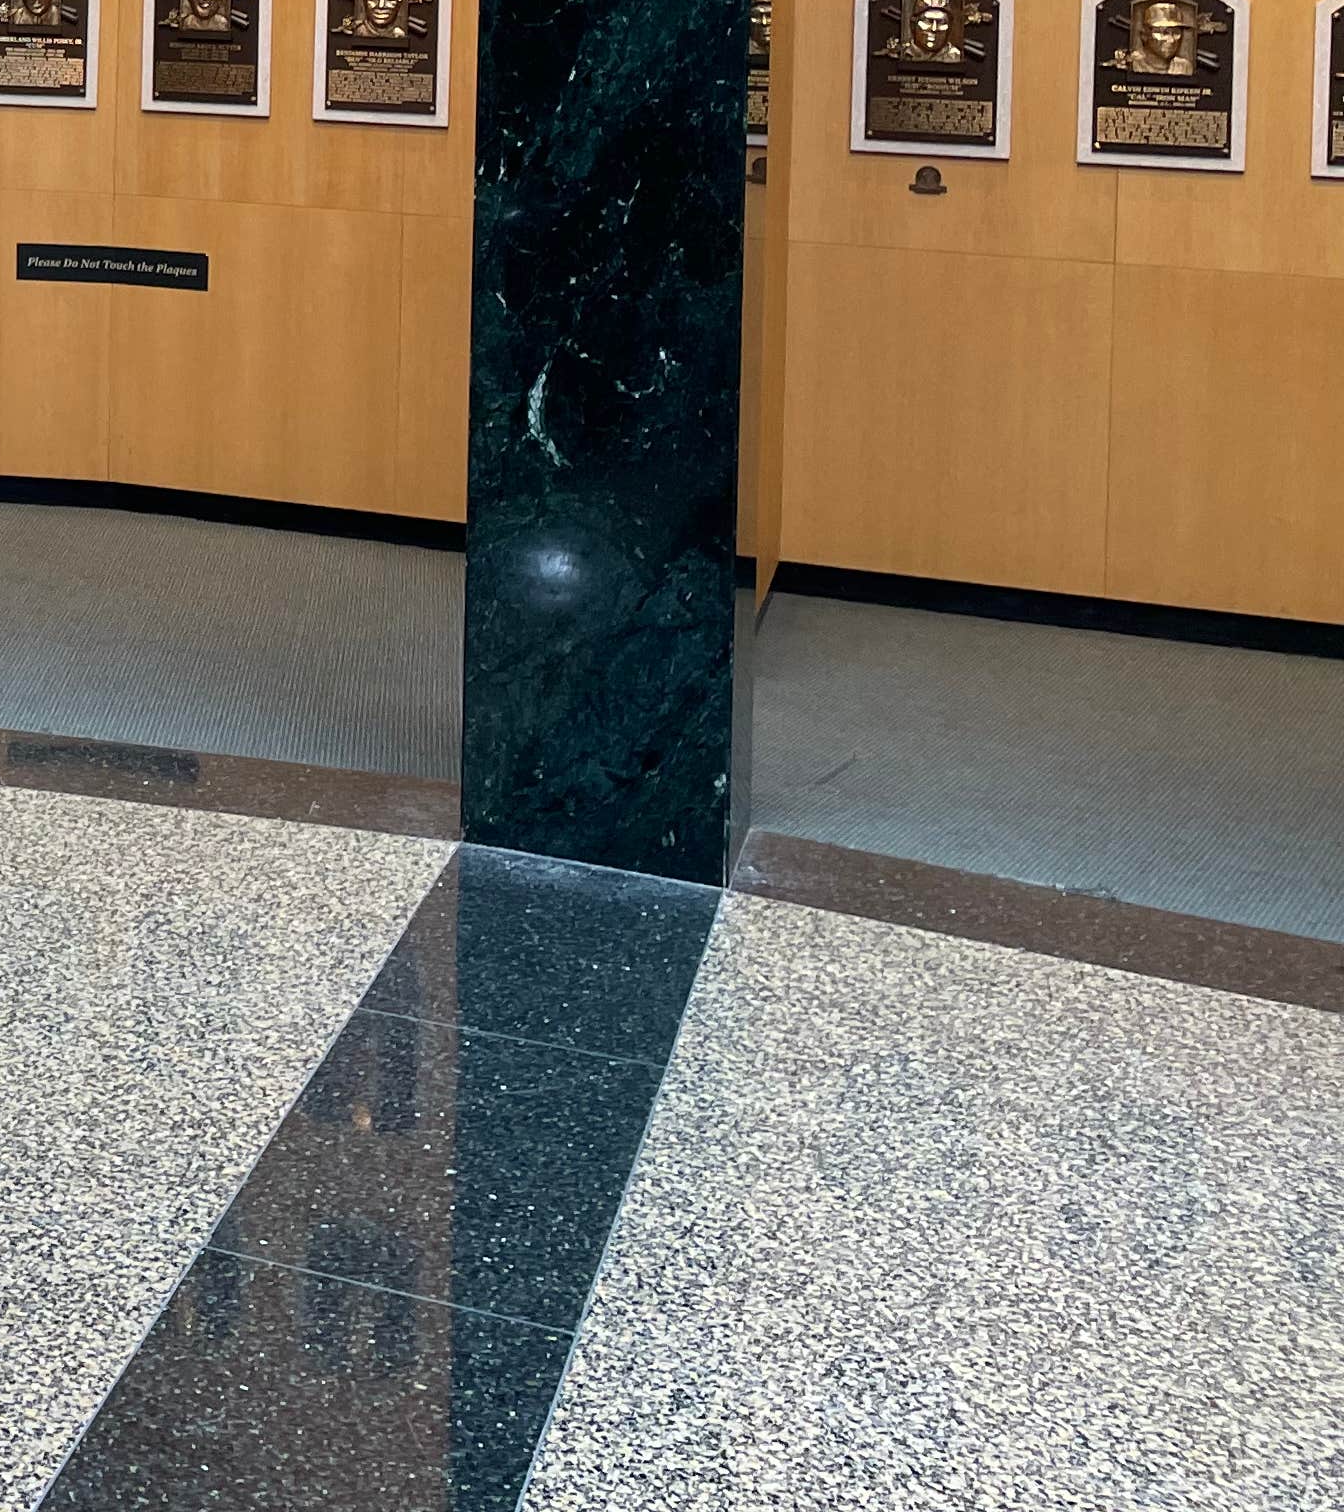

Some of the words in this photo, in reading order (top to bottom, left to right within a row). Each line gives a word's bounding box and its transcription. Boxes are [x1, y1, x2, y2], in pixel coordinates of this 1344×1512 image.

[27, 257, 61, 267] Please
[63, 258, 78, 268] Do
[81, 259, 101, 269] Not
[103, 260, 135, 271] Touch
[137, 261, 154, 272] the
[156, 263, 198, 277] Plaques
